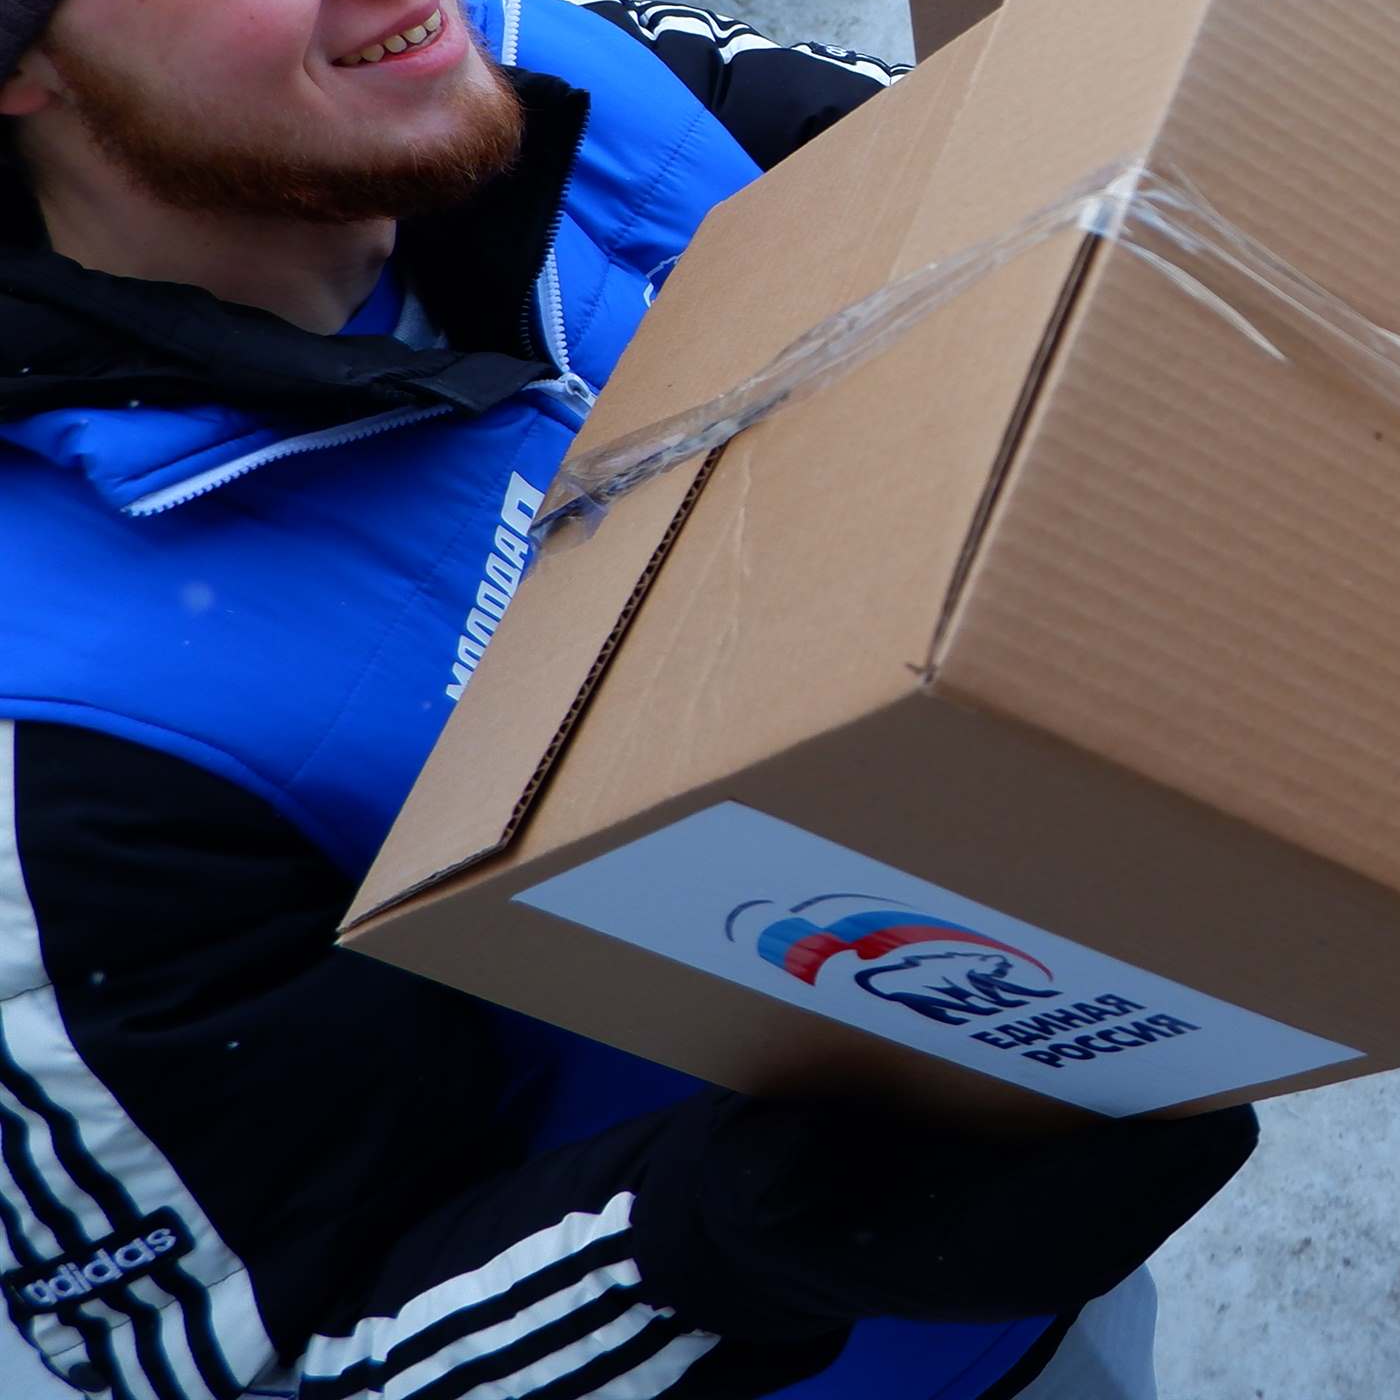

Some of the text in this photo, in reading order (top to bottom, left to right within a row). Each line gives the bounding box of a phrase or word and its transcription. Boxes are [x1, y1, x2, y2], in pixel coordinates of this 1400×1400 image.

[968, 992, 1148, 1050] ЕДИНАЯ
[1020, 1013, 1202, 1069] РОССИЯ
[24, 1228, 177, 1304] adidas
